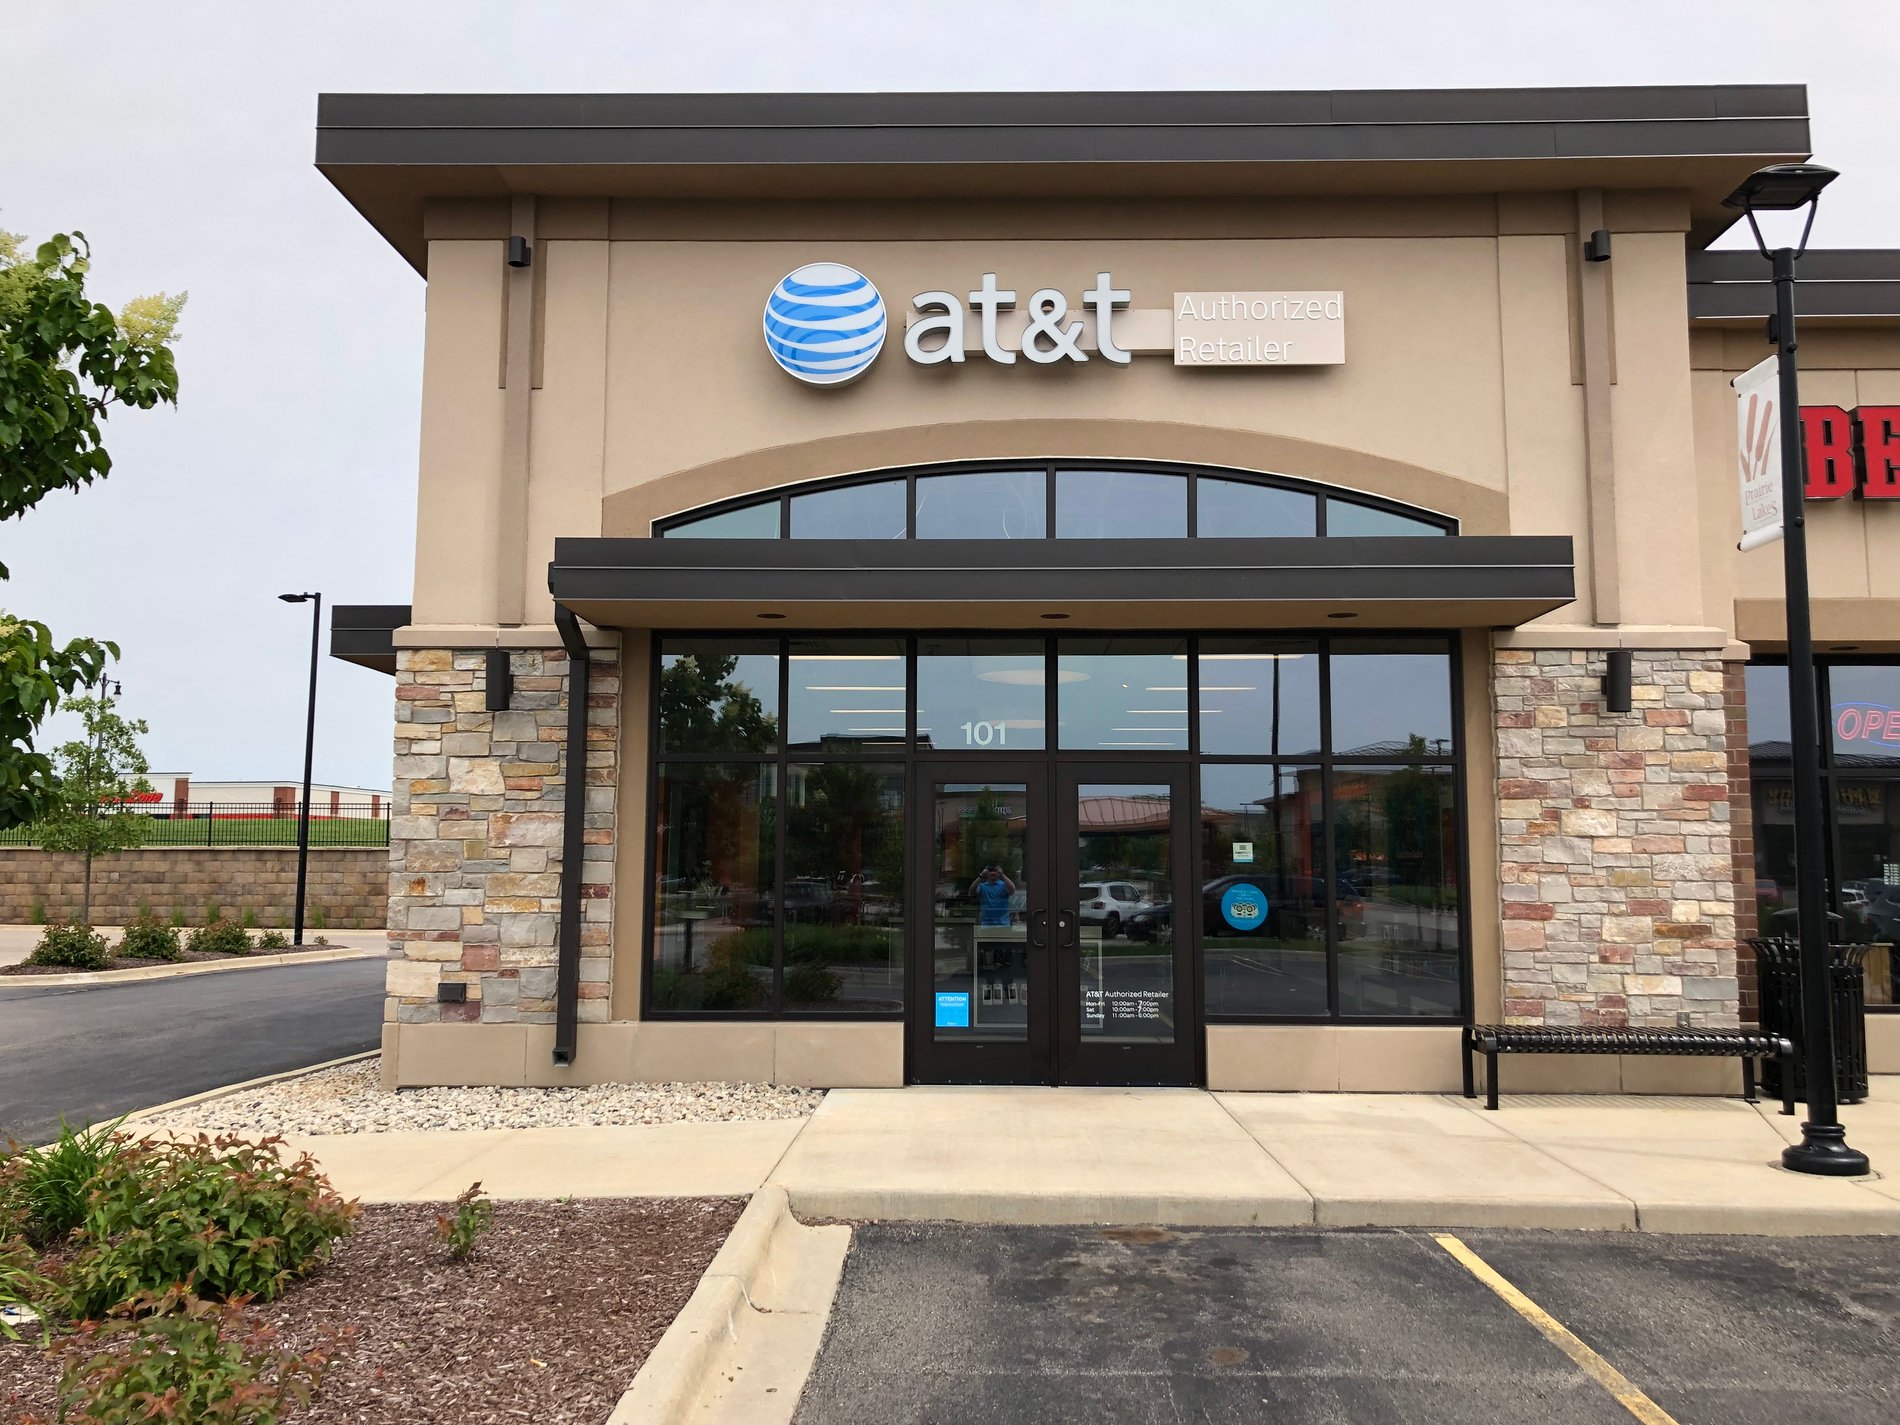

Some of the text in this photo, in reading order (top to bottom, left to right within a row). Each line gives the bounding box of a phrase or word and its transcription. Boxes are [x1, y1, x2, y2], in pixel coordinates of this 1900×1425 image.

[904, 272, 1131, 365] at&t
[1178, 293, 1342, 321] Authorized
[1179, 337, 1293, 361] Retailer
[1745, 481, 1774, 505] Prairie
[1751, 501, 1778, 520] Lakes
[960, 721, 1006, 745] 101
